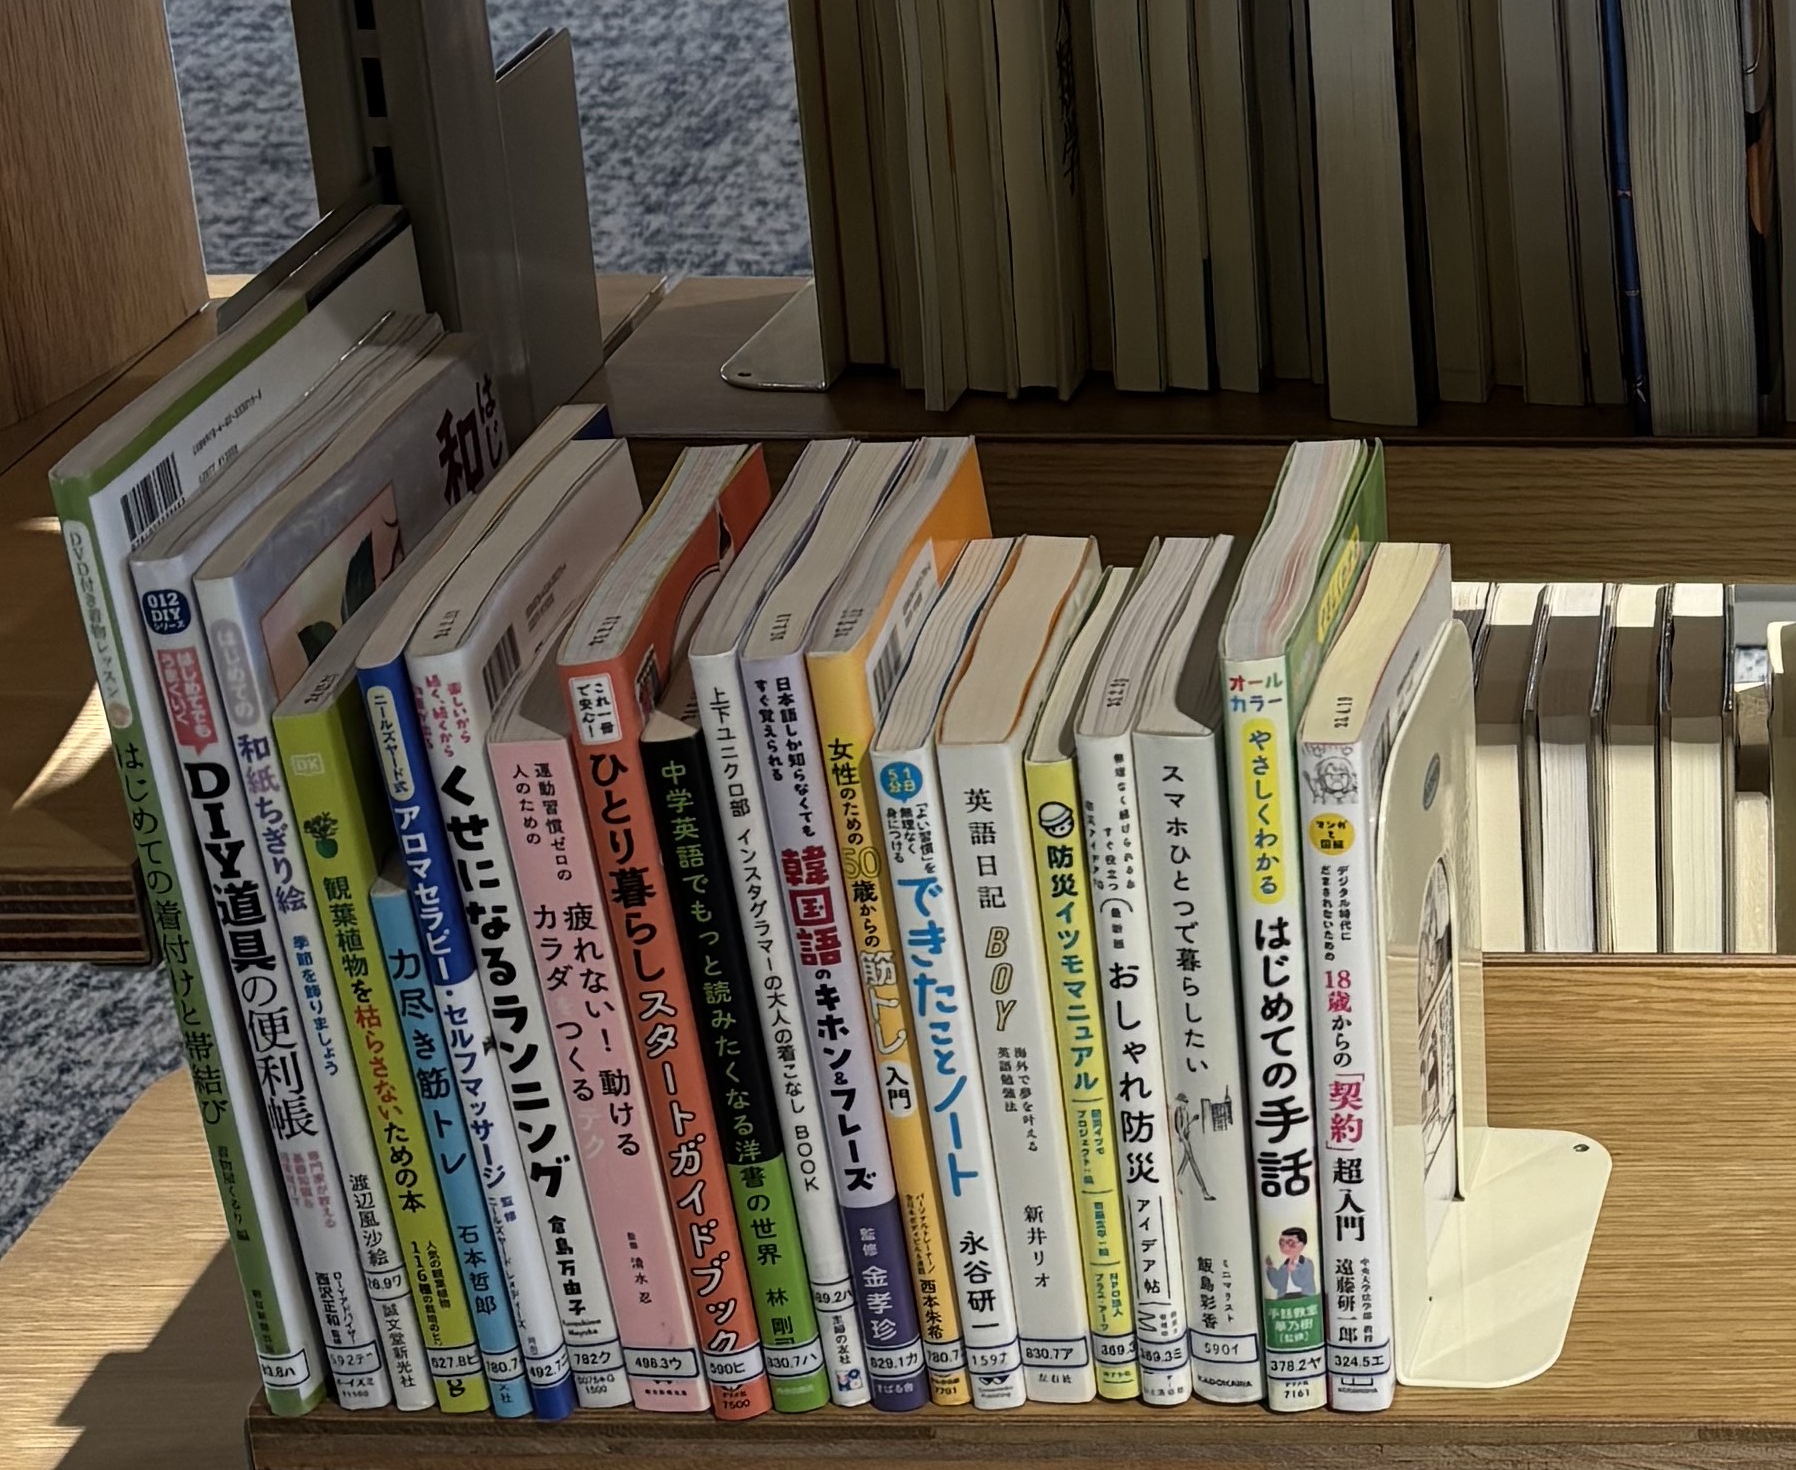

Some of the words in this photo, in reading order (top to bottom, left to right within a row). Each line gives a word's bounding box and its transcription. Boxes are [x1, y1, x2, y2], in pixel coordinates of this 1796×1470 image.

[147, 591, 179, 608] 012
[150, 607, 182, 623] DIY
[215, 628, 256, 720] はじめての
[1229, 672, 1283, 692] オール
[1231, 696, 1283, 713] カラー
[375, 695, 409, 793] ニールズヤード式
[755, 679, 783, 781] すぐ覚えられる
[776, 677, 815, 837] 日本語しか知らなくても
[237, 734, 308, 914] 和紙ちぎり絵
[513, 763, 542, 846] 人のための
[533, 762, 573, 882] 運動習慣ゼロの
[1249, 730, 1279, 894] やさしくわかる
[115, 742, 229, 1126] はじめての着付けと帯結び
[184, 762, 319, 1142] DIY道具の便利帳
[710, 687, 752, 818] 上下ユニクロ部
[736, 829, 805, 1114] インスタグラマーの大人の着こなし
[795, 1125, 820, 1193] BOOK
[1047, 845, 1099, 1092] 防災イツモマニュアル
[1162, 766, 1208, 1073] スマホひとつで暮らしたい
[293, 935, 340, 1077] 季節を飾りましょう
[394, 805, 506, 1190] アロマセラピー・セルフマッサージ
[441, 765, 570, 1198] くせになるランニング
[662, 761, 782, 1266] 中学英語でもっと読みたくなる洋書の世界
[781, 846, 877, 1192] 韓国語のキホン&フレーズ
[323, 876, 427, 1214] 観葉植物を枯らさないための本
[388, 950, 466, 1175] 力尽き筋トレ
[590, 753, 738, 1352] ひとり暮らしスタートガイドブック
[897, 876, 980, 1197] できたことノート
[997, 1047, 1018, 1113] 英語勉強法
[1254, 916, 1313, 1198] はじめての手話
[885, 1066, 912, 1111] 入門
[1014, 1047, 1039, 1152] 海外で夢を叶える
[1108, 962, 1160, 1183] おしゃれ防災
[1137, 1199, 1161, 1294] アイデア帖
[457, 1225, 497, 1314] 石本哲郎
[547, 1215, 585, 1315] 倉島万由子
[860, 1228, 877, 1256] 監修
[959, 1231, 1000, 1329] 永谷研一
[1024, 1204, 1051, 1289] 新井リオ
[383, 1304, 416, 1388] 誠文堂新光社
[766, 1288, 789, 1306] 林
[862, 1265, 896, 1341] 金孝珍
[1335, 1258, 1358, 1344] 遠藤研一郎
[575, 1352, 611, 1365] 782ク
[1026, 1347, 1074, 1362] 830.7ア
[1270, 1358, 1322, 1372] 378.2ヤ
[1335, 1355, 1385, 1367] 324.5エ
